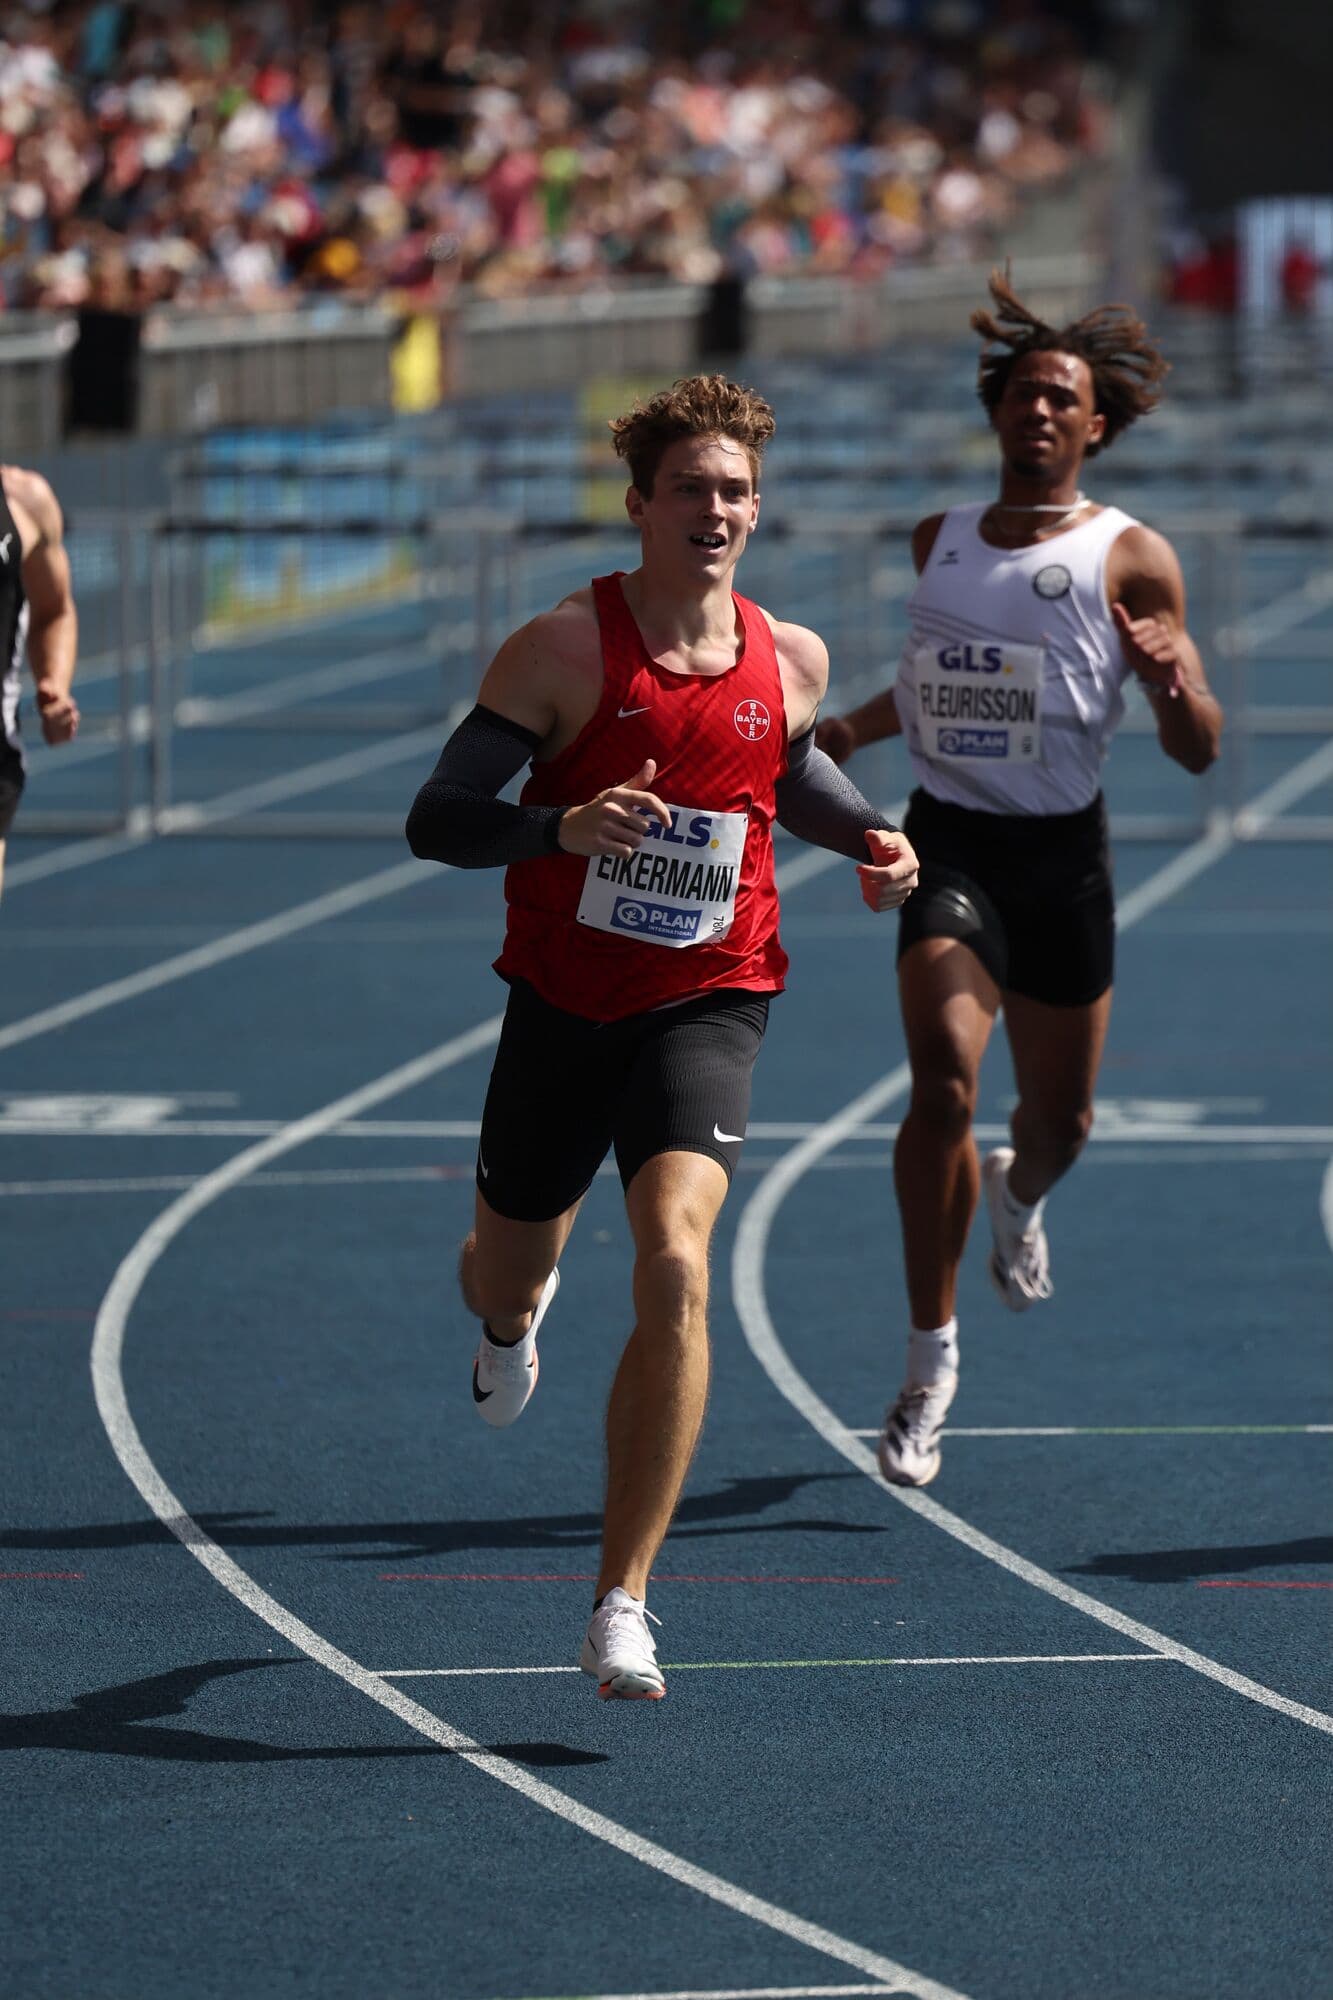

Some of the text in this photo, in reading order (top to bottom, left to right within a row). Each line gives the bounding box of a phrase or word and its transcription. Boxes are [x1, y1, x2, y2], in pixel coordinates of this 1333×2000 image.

[920, 683, 1035, 722] FLEURISSON
[737, 714, 768, 725] BAYER
[963, 734, 1005, 747] PLAN
[597, 851, 735, 902] EIKERMANN
[650, 911, 698, 930] PLAN
[712, 916, 724, 933] 780
[648, 926, 693, 937] INTERNATIONAL
